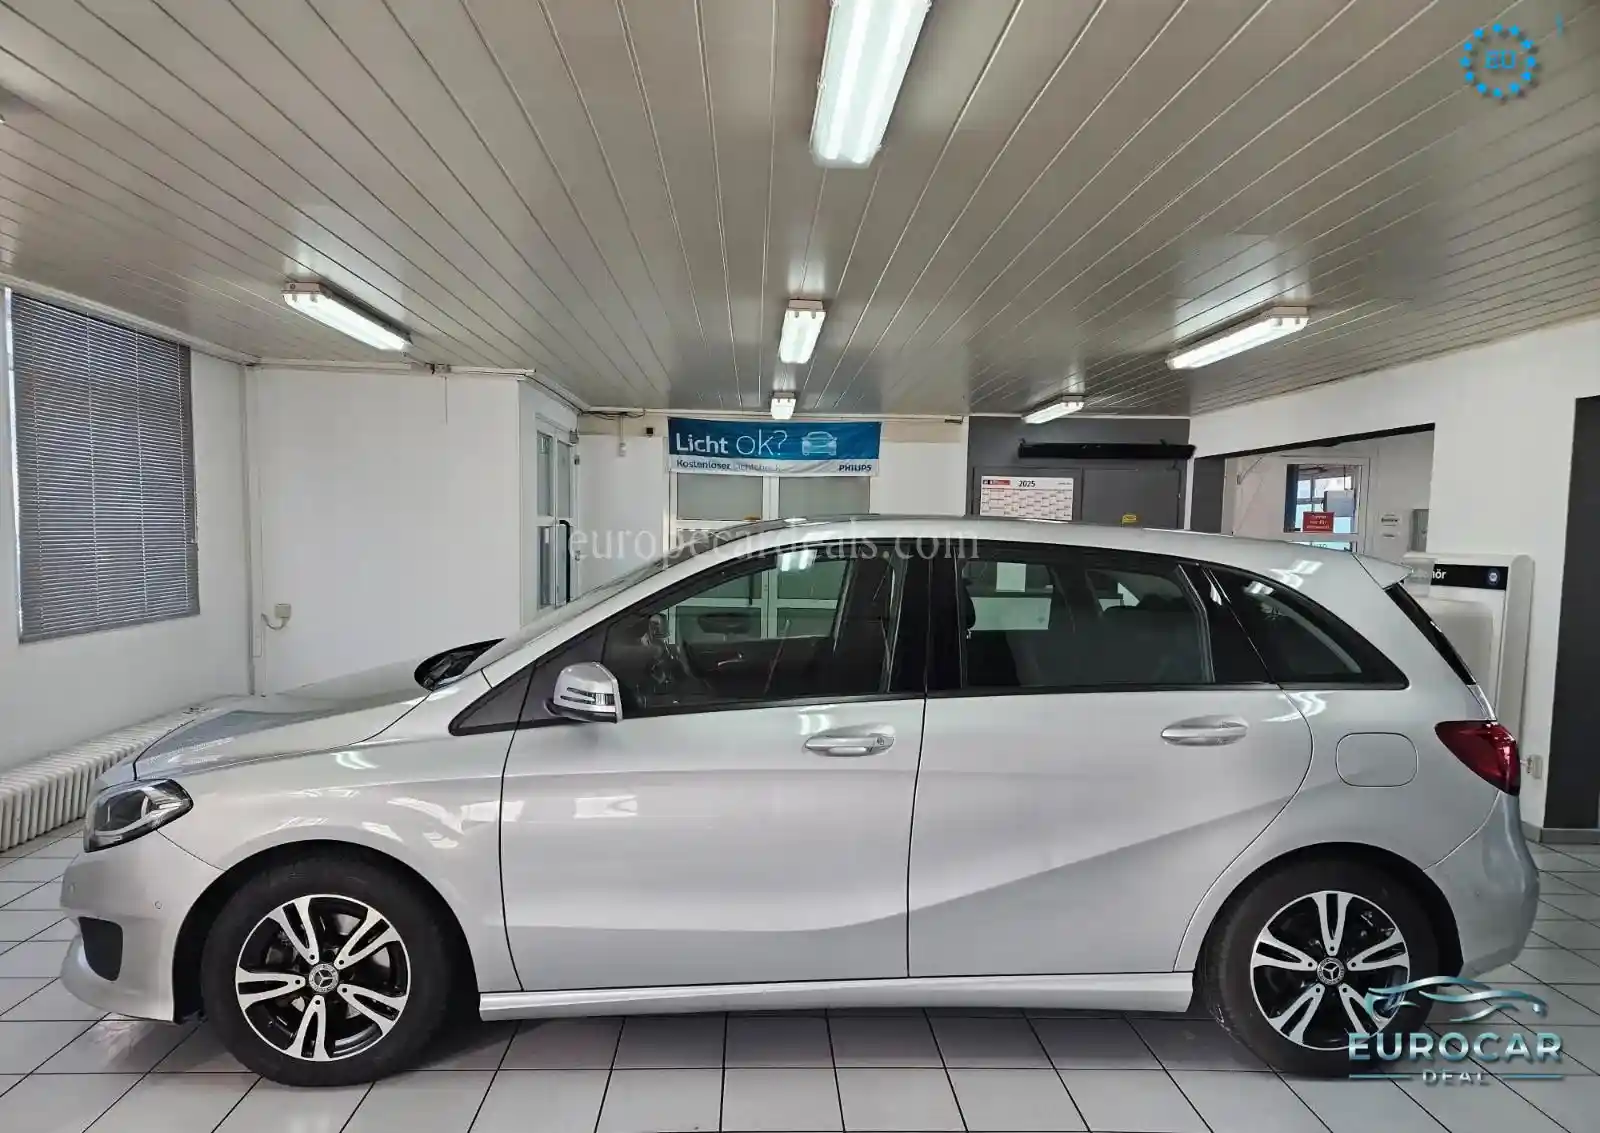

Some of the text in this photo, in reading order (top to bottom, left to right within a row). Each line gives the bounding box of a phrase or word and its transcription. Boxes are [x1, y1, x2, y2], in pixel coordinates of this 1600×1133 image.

[676, 429, 788, 456] Licht ok?
[676, 460, 731, 470] Kostenloser
[838, 464, 872, 472] PHILIPS
[1018, 480, 1036, 488] 2025
